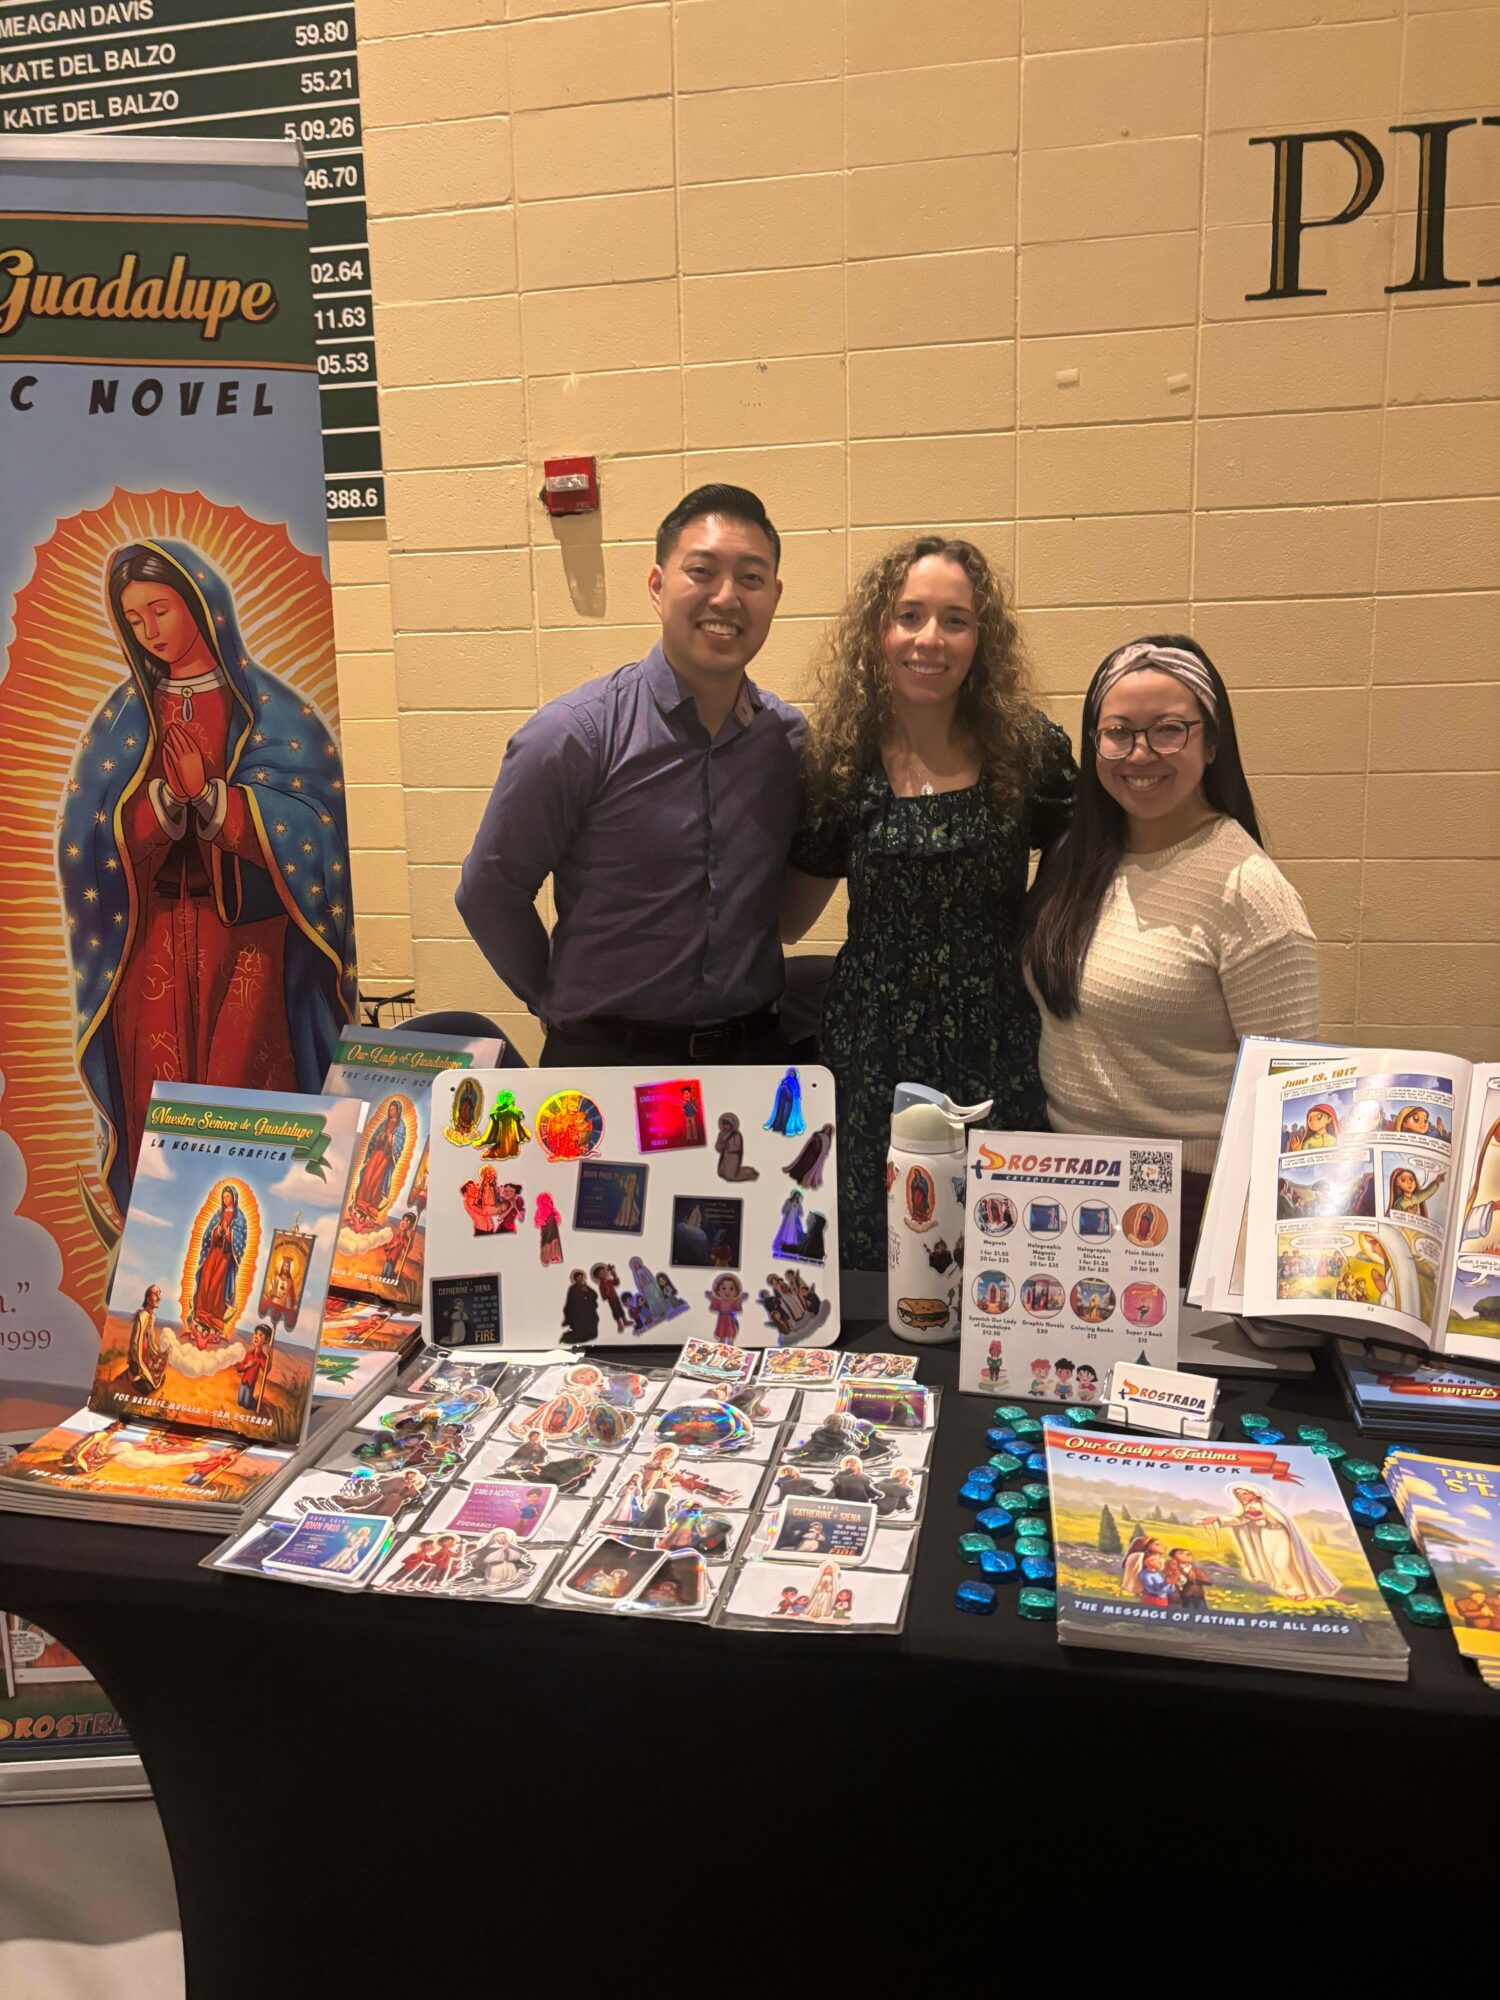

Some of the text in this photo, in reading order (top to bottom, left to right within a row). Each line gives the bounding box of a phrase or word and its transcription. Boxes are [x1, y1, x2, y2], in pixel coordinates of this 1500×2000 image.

[0, 0, 154, 38] MEAGAN DAVIS
[295, 20, 349, 46] 59.80
[1, 43, 176, 84] KATE DEL BALZO
[300, 68, 353, 94] 55.21
[3, 90, 179, 129] KATE DEL BALZO
[304, 166, 357, 190] 46.70
[310, 260, 363, 284] 02.64
[0, 249, 277, 338] Guadalupe
[314, 306, 366, 330] 11.63
[317, 352, 369, 375] 05.53
[88, 377, 274, 417] NOVEL
[326, 487, 378, 510] 388.6
[347, 1044, 368, 1061] Our
[370, 1046, 397, 1067] Lady
[398, 1052, 412, 1063] of
[341, 1070, 359, 1080] THE
[151, 1106, 314, 1142] Nuestra Señora de Guadalupe
[150, 1138, 288, 1162] LA NOVELA GRAFICA
[1003, 1318, 1017, 1326] Lady
[1021, 1319, 1044, 1327] Graphic
[1070, 1324, 1096, 1332] Coloring
[0, 1329, 51, 1351] 1999
[474, 1328, 497, 1343] FIRE
[1431, 1386, 1498, 1399] Fatima
[113, 1392, 130, 1401] POR
[131, 1395, 166, 1408] NATALIE
[168, 1402, 202, 1415] MUGLIA
[211, 1409, 231, 1420] SAM
[233, 1413, 274, 1427] ESTRADA
[1064, 1436, 1240, 1462] Our Lady of Fatima
[1066, 1452, 1241, 1475] COLORING BOOK
[1434, 1467, 1490, 1484] THE
[474, 1487, 494, 1497] CARLO
[303, 1520, 322, 1531] JOHN
[322, 1522, 340, 1533] PAUL
[792, 1507, 862, 1523] CATHERINE SIENA
[1074, 1600, 1351, 1635] THE MESSAGE OF FATIMA FOR ALL AGES
